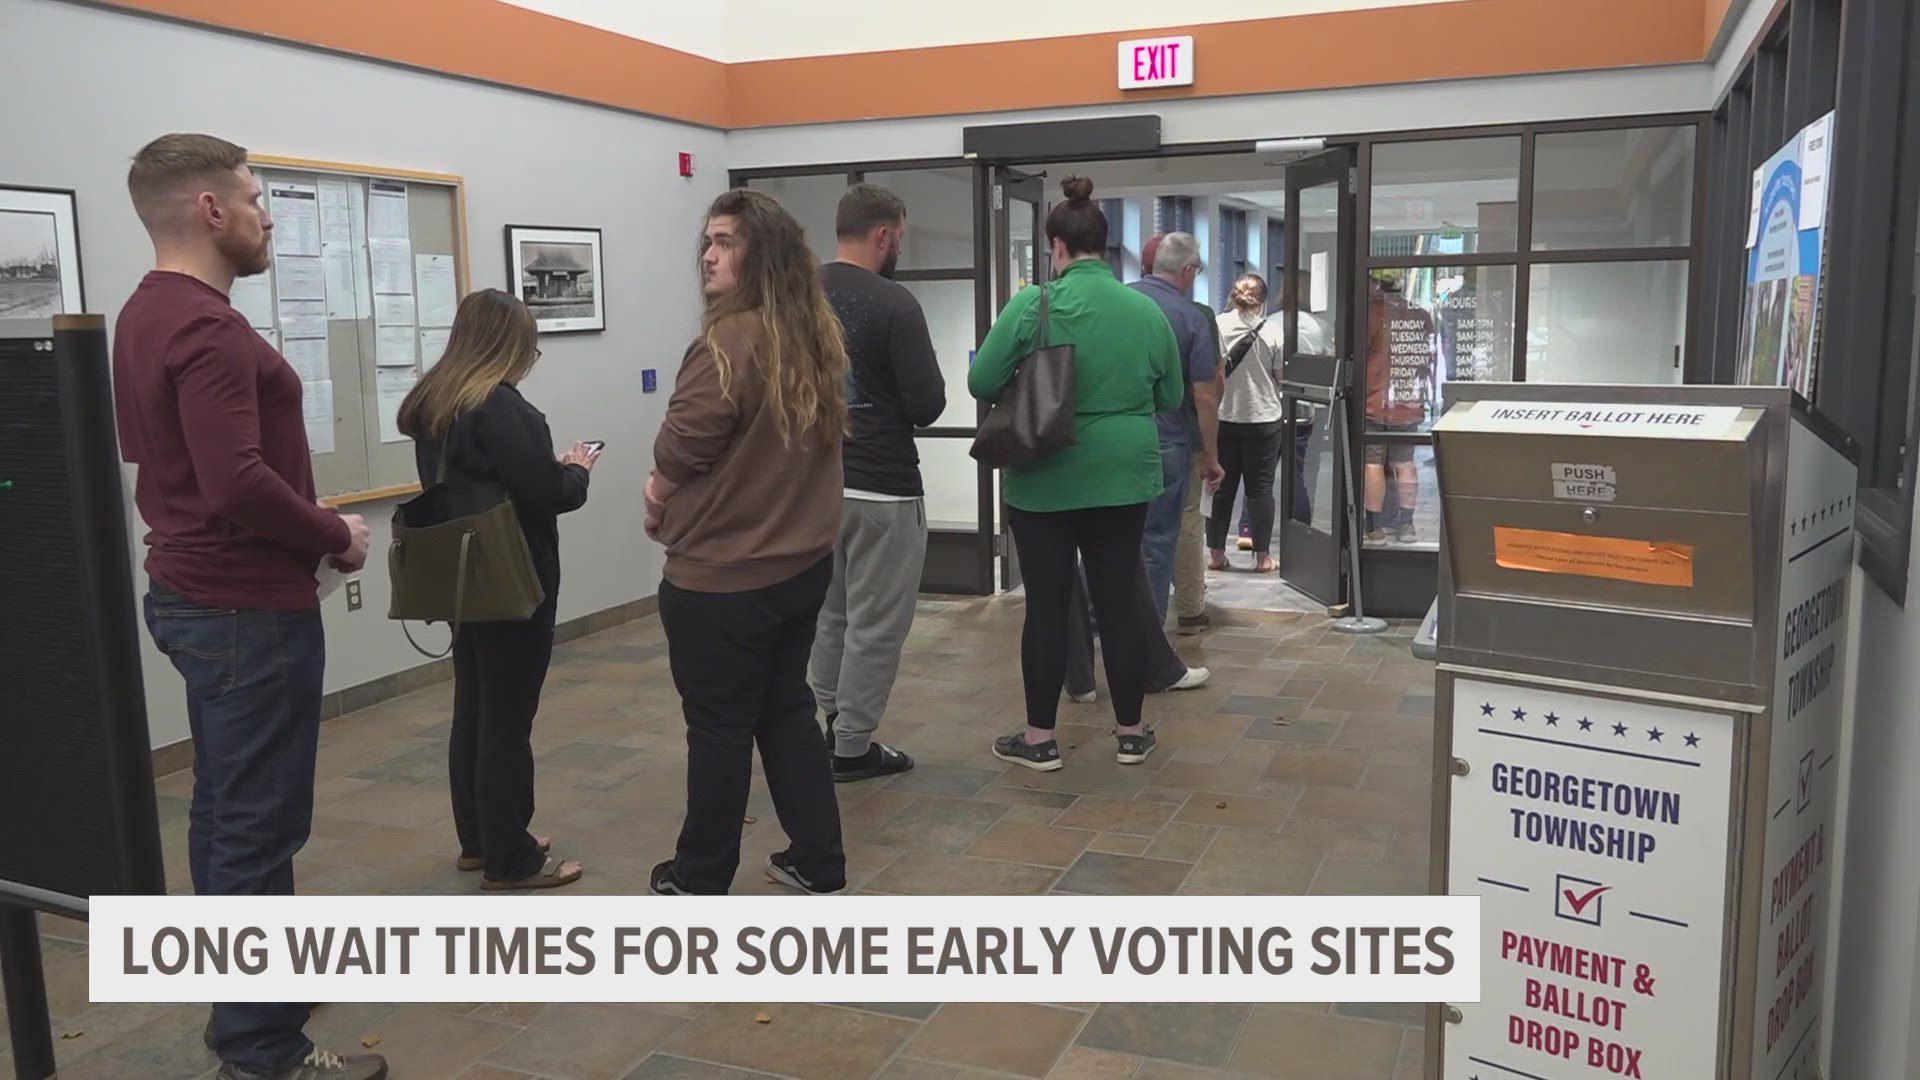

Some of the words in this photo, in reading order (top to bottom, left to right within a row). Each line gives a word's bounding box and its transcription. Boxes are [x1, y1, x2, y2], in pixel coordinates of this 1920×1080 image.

[1134, 44, 1180, 81] EXIT
[1445, 296, 1478, 309] HOURS
[1390, 319, 1426, 330] MONDAY
[1390, 332, 1425, 342] TUESDAY
[1390, 355, 1431, 366] THURSDAY
[1389, 367, 1417, 377] FRIDAY
[1491, 408, 1563, 421] INSERT
[1564, 410, 1646, 424] BALLOT
[1646, 412, 1706, 426] HERE
[1563, 467, 1605, 480] PUSH
[1566, 485, 1606, 498] HERE
[1491, 762, 1681, 826] GEORGETOWN
[1510, 807, 1656, 864] TOWNSHIP
[1501, 930, 1627, 989] PAYMENT
[1633, 962, 1656, 998] &
[1525, 977, 1627, 1032] BALLOT
[1507, 1014, 1580, 1061] DROP
[1587, 1035, 1643, 1080] BOX
